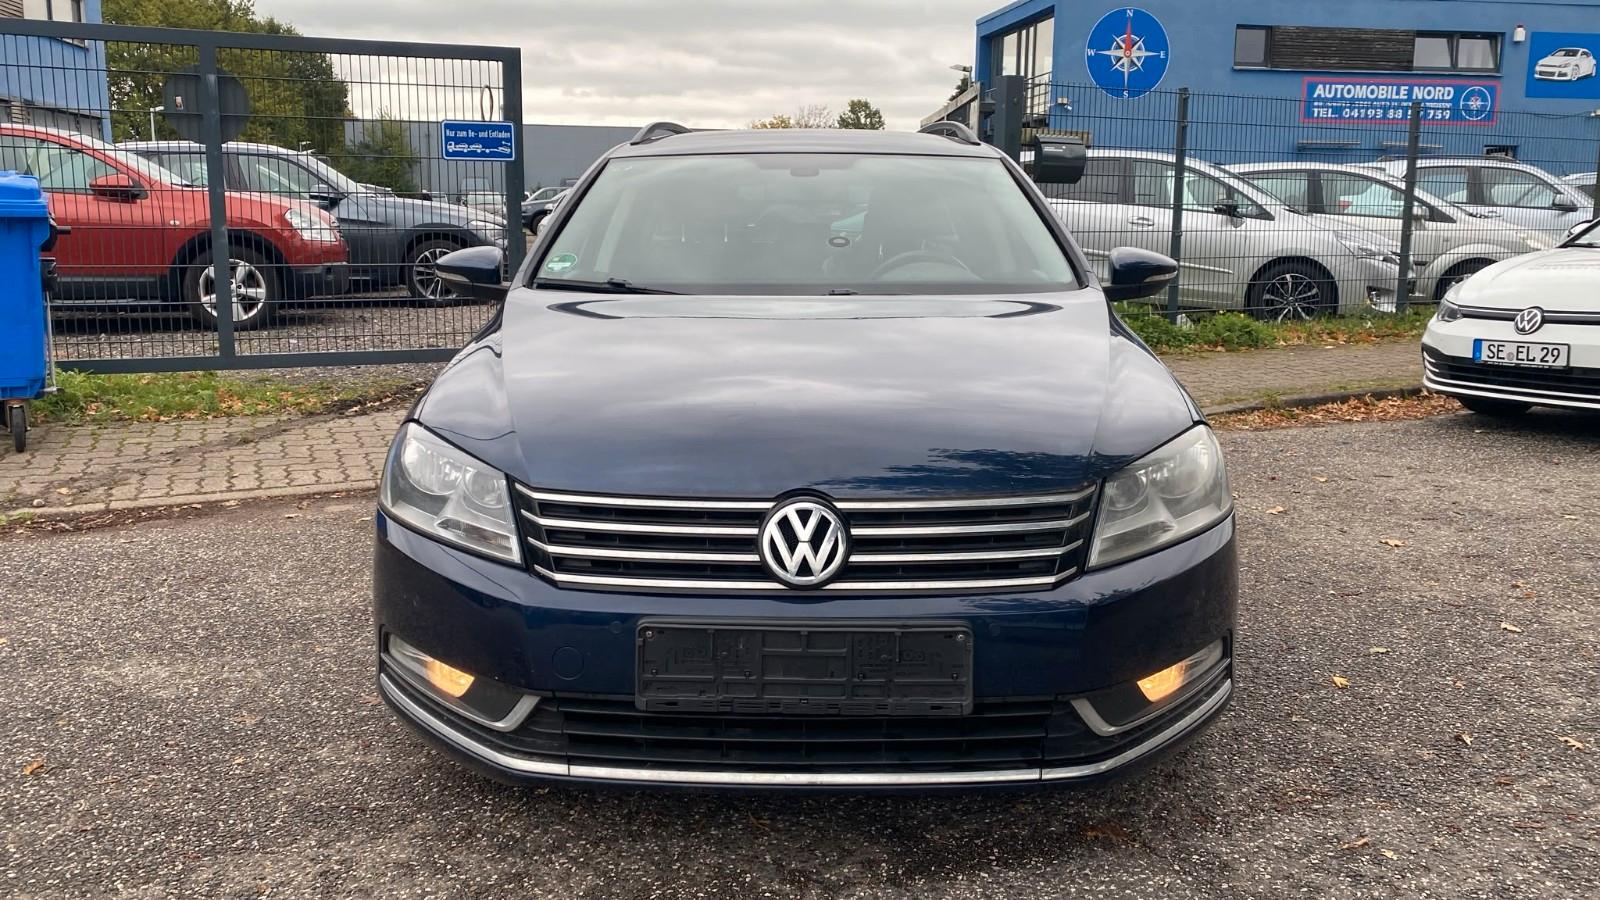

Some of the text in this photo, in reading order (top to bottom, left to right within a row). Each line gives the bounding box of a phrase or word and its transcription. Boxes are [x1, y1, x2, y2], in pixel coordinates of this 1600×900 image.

[1126, 9, 1134, 17] N
[1087, 48, 1096, 56] W
[1159, 51, 1166, 59] E
[1123, 90, 1129, 98] S
[1313, 84, 1455, 100] AUTOMOBILE NORD
[1312, 108, 1338, 118] TEL.
[1342, 108, 1383, 119] 04193
[1387, 109, 1403, 119] 88
[1427, 109, 1451, 120] 759
[446, 129, 455, 137] Nur
[478, 130, 488, 138] und
[489, 130, 511, 139] Entladen
[1517, 309, 1541, 332] VW
[1487, 343, 1561, 363] SE EL 29
[764, 503, 847, 584] VW
